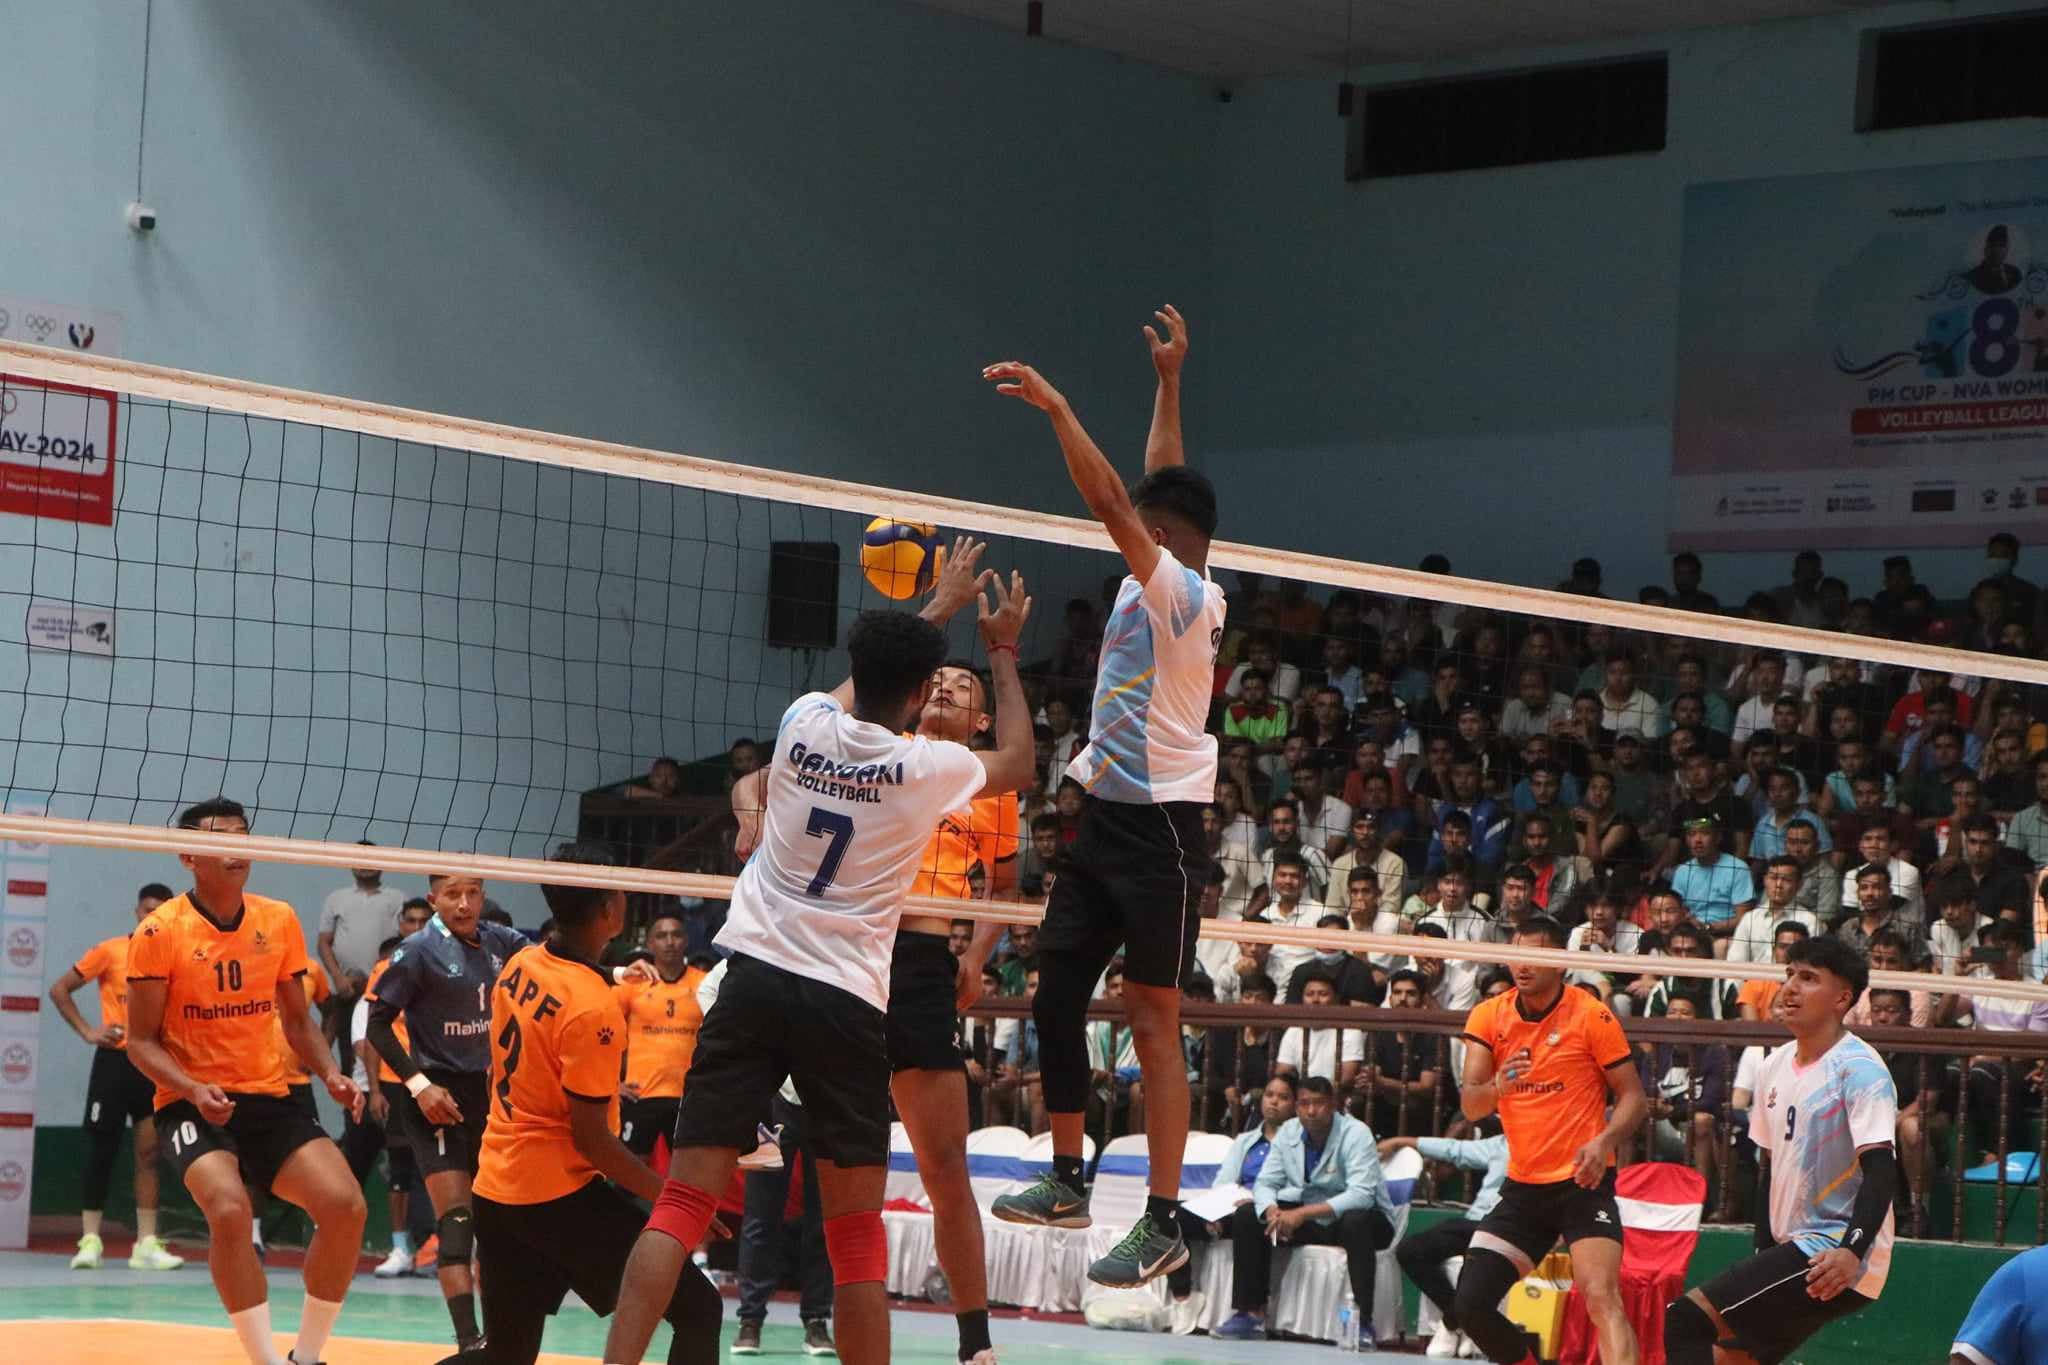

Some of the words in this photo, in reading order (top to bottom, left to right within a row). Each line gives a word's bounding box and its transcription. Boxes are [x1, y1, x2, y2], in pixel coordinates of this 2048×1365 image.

[1969, 297, 2021, 378] 8
[1868, 385, 1895, 403] PM
[1900, 383, 1937, 401] CUP
[1953, 382, 1993, 400] NVA
[1879, 406, 1985, 427] VOLLEYBALL
[1989, 403, 2048, 423] LEAGU
[788, 741, 904, 786] GANDAKI
[796, 772, 882, 804] VOLLEYBALL
[805, 806, 856, 898] 7
[213, 959, 242, 992] 10
[477, 981, 486, 1012] 1
[500, 966, 562, 1022] APF
[665, 999, 675, 1018] 3
[90, 1101, 101, 1123] 8
[1784, 1105, 1796, 1141] 9
[170, 1120, 198, 1156] 10
[433, 1128, 446, 1156] 1
[621, 1120, 634, 1143] 3
